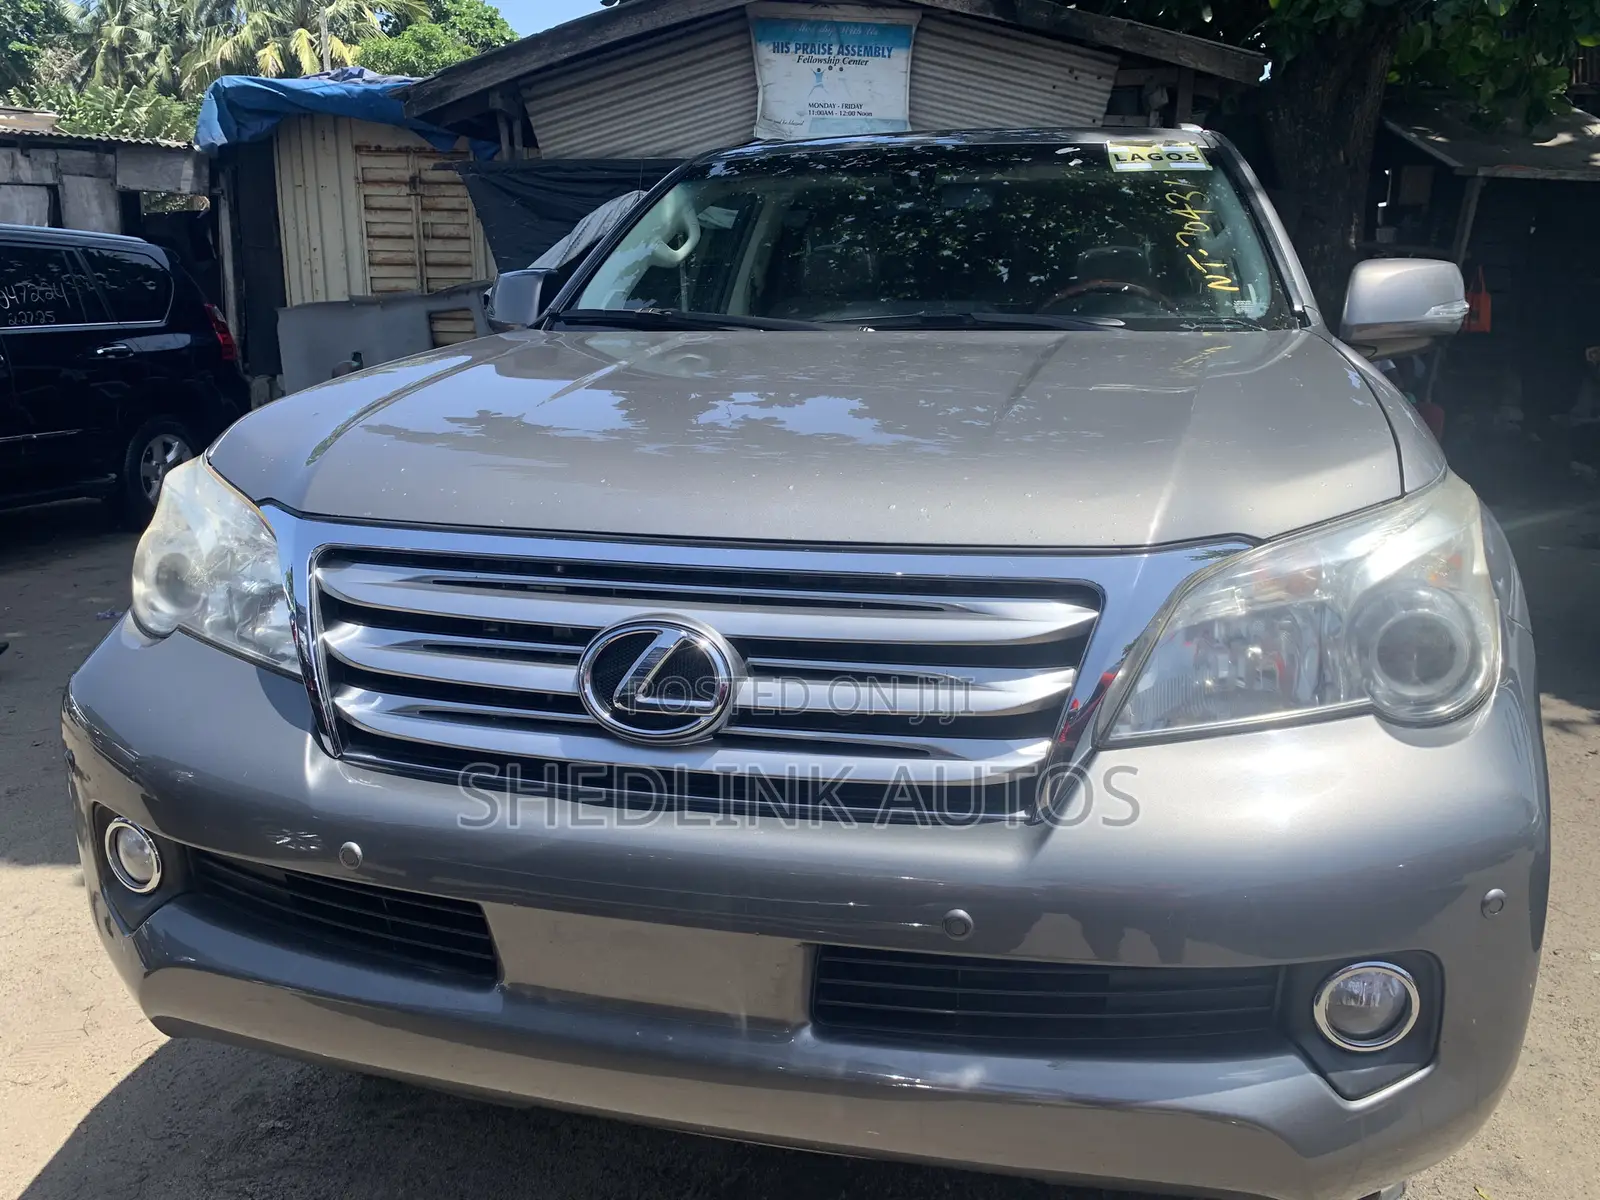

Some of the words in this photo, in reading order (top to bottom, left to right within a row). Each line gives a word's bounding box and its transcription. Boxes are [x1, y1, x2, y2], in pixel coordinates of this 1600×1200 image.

[772, 41, 791, 54] HIS
[794, 42, 833, 56] PRAISE
[837, 44, 894, 59] ASSEMBLY
[796, 55, 840, 66] Fellowship
[842, 57, 869, 67] Center
[808, 102, 836, 110] MONDAY
[1113, 152, 1200, 162] LAGOS
